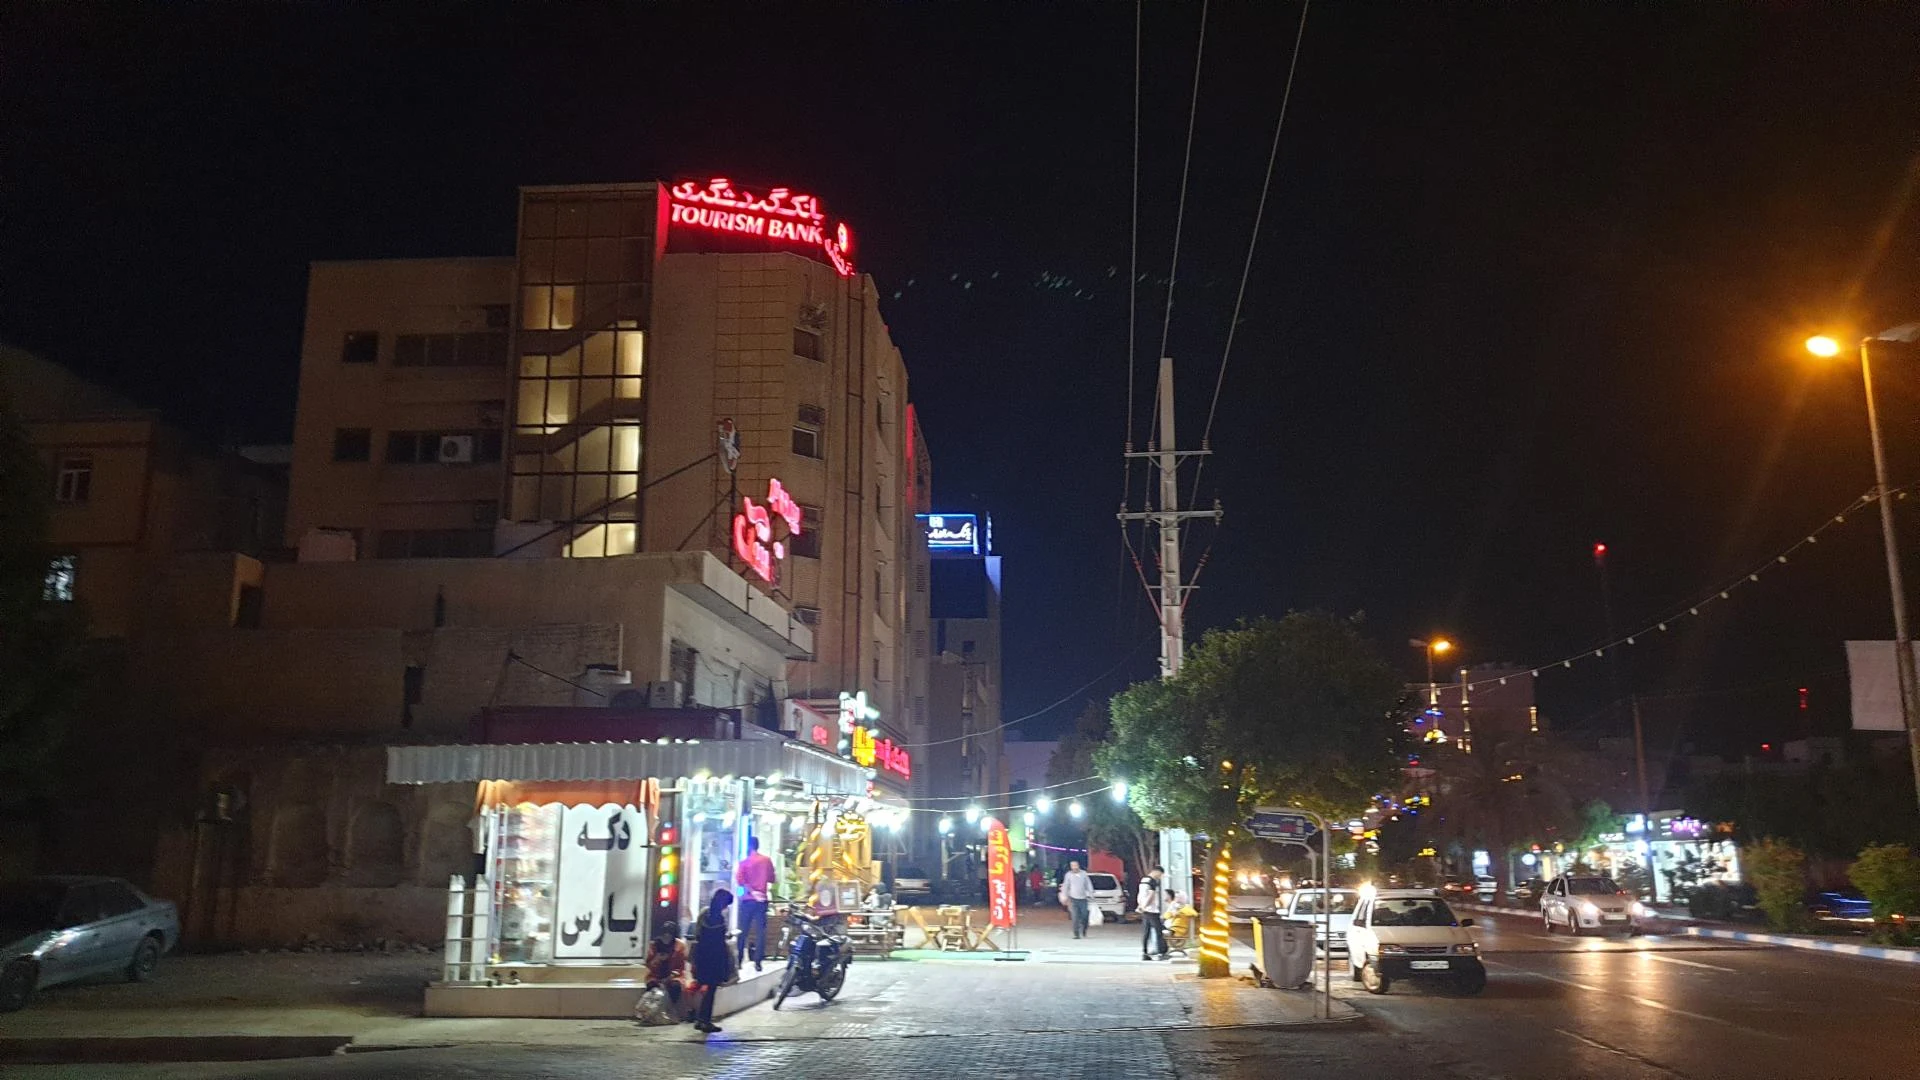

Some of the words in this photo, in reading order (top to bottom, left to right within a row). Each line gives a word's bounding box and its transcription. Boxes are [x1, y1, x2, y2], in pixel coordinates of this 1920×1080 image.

[672, 178, 789, 213] گردشگری
[777, 194, 825, 226] بانک
[671, 203, 765, 235] TOURISM
[767, 218, 824, 245] BANK
[577, 811, 631, 851] دکه
[988, 829, 1009, 875] شاورما
[561, 891, 638, 949] پارس
